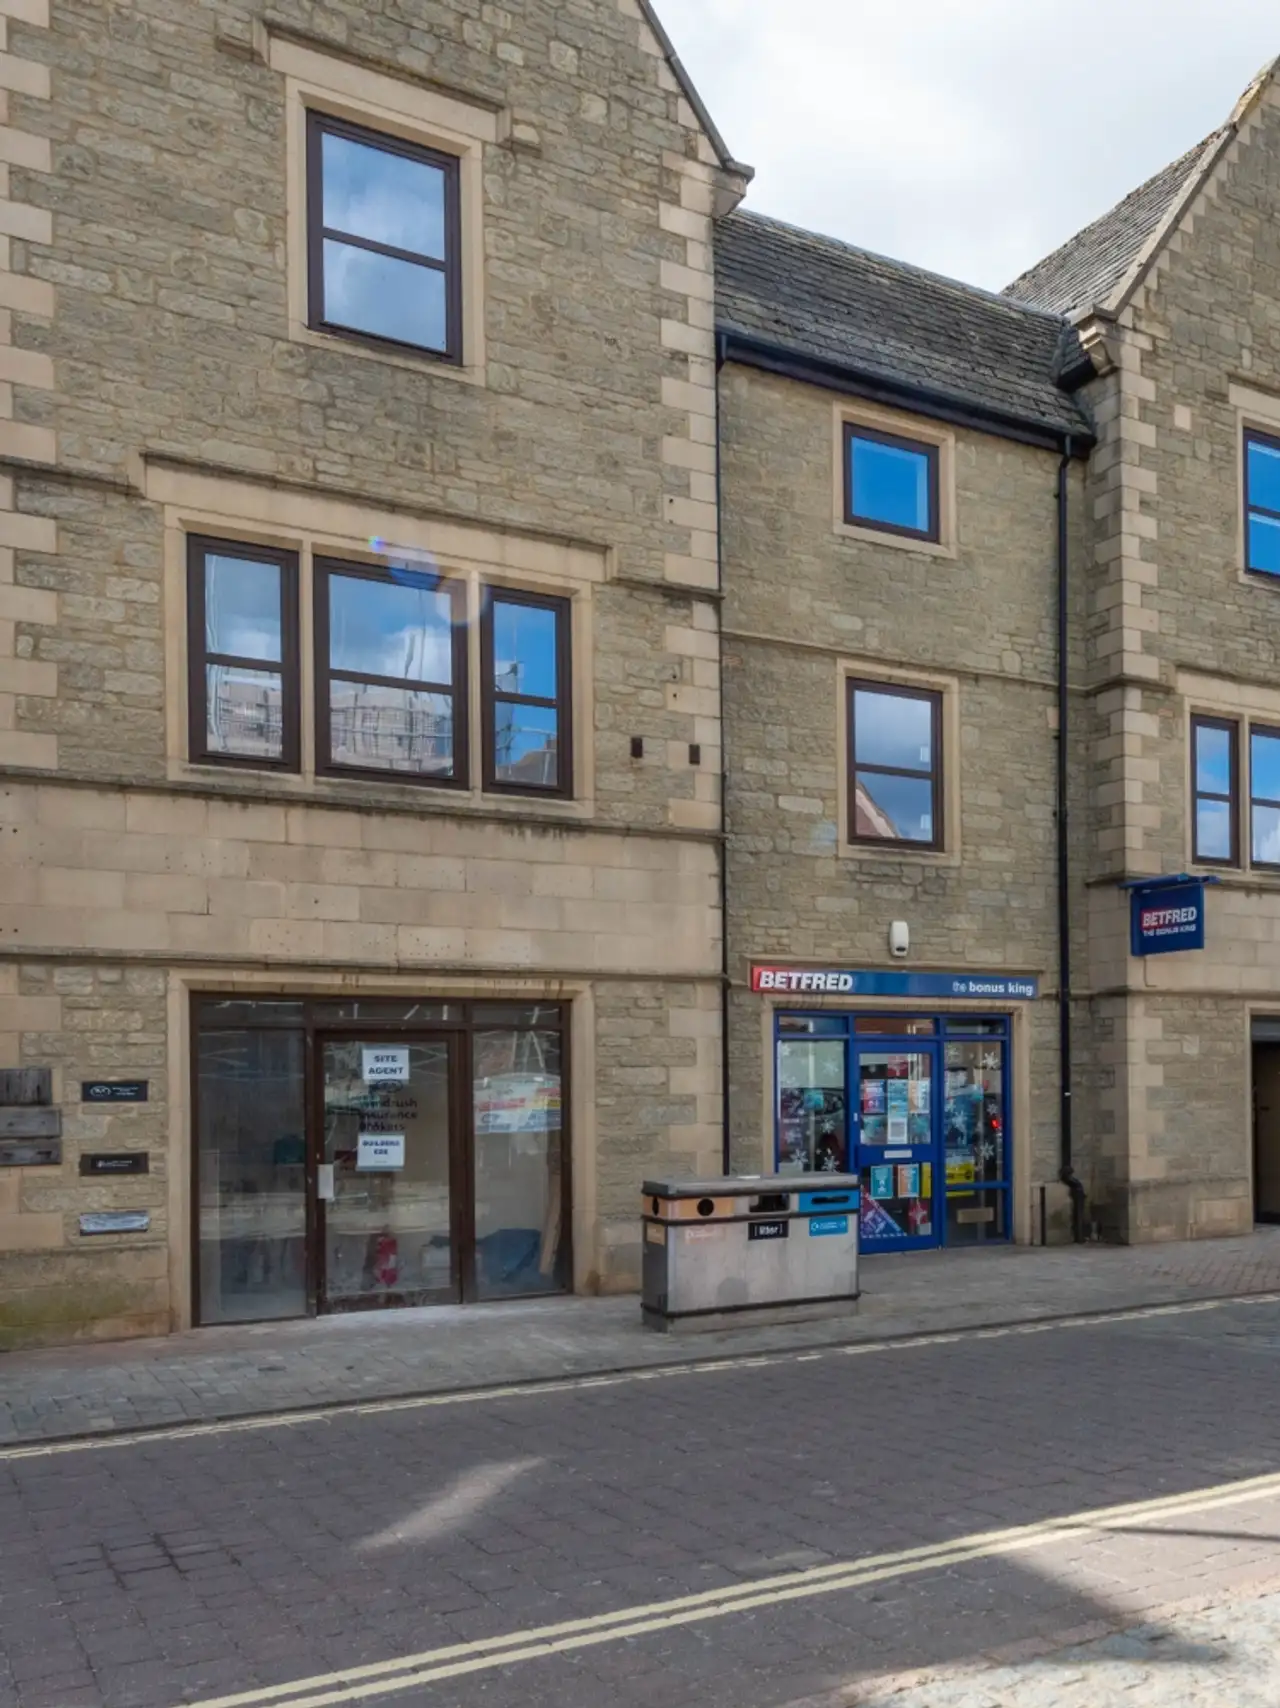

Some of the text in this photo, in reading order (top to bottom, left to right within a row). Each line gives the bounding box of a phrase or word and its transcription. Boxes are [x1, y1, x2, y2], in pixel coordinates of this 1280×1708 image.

[1143, 906, 1198, 927] BETFRED
[759, 971, 1034, 996] BETFRED the bonus king
[373, 1055, 398, 1063] SITE
[368, 1066, 404, 1075] AGENT
